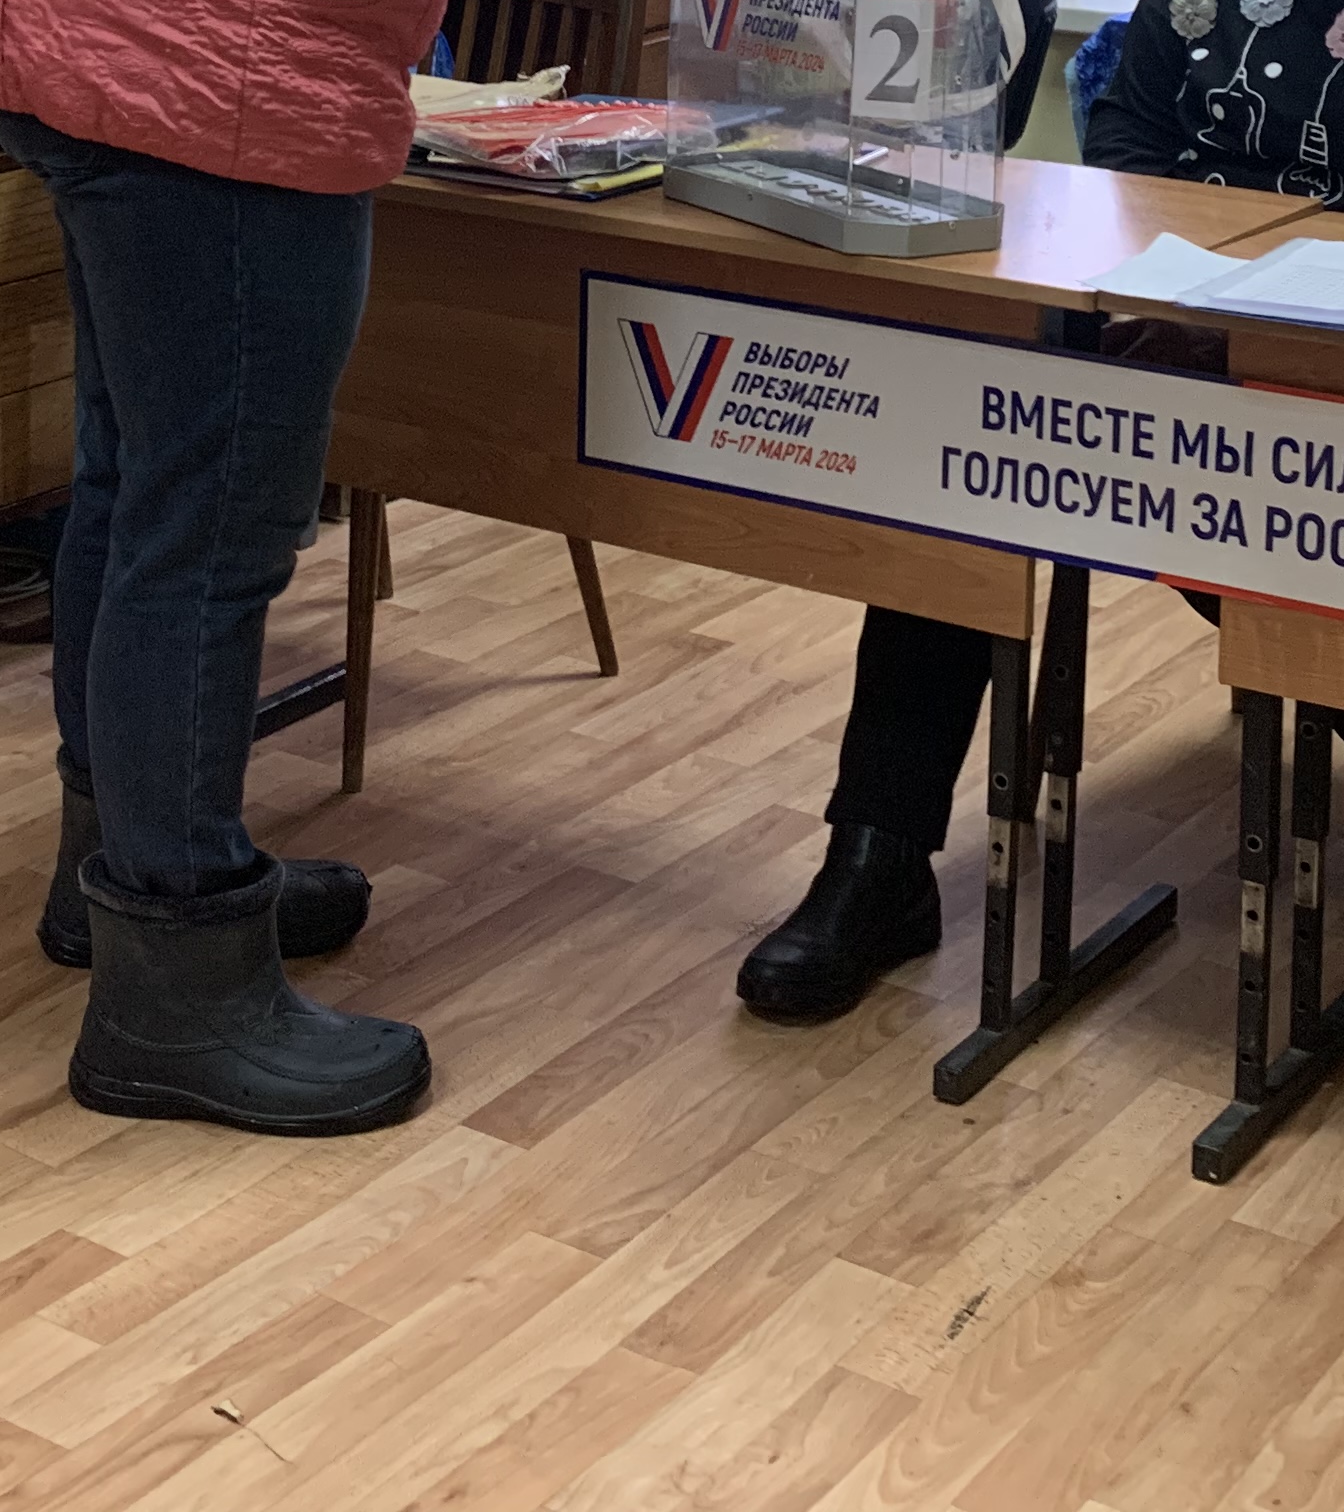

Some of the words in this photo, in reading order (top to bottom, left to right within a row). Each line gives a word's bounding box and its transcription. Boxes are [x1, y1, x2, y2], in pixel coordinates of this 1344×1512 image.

[742, 13, 799, 42] РОССИИ
[764, 44, 797, 66] МАРТА
[798, 53, 825, 73] 2024
[864, 14, 921, 104] 2
[743, 341, 851, 380] ВЫБОРЫ
[731, 371, 881, 419] ПРЕЗИДЕНТА
[719, 401, 815, 438] РОССИИ
[981, 385, 1156, 460] ВМЕСТЕ
[1171, 418, 1255, 478] МЫ
[756, 438, 813, 467] МАРТА
[815, 449, 857, 475] 2024
[941, 445, 1175, 534] ГОЛОСУЕМ
[1190, 493, 1249, 548] ЗА
